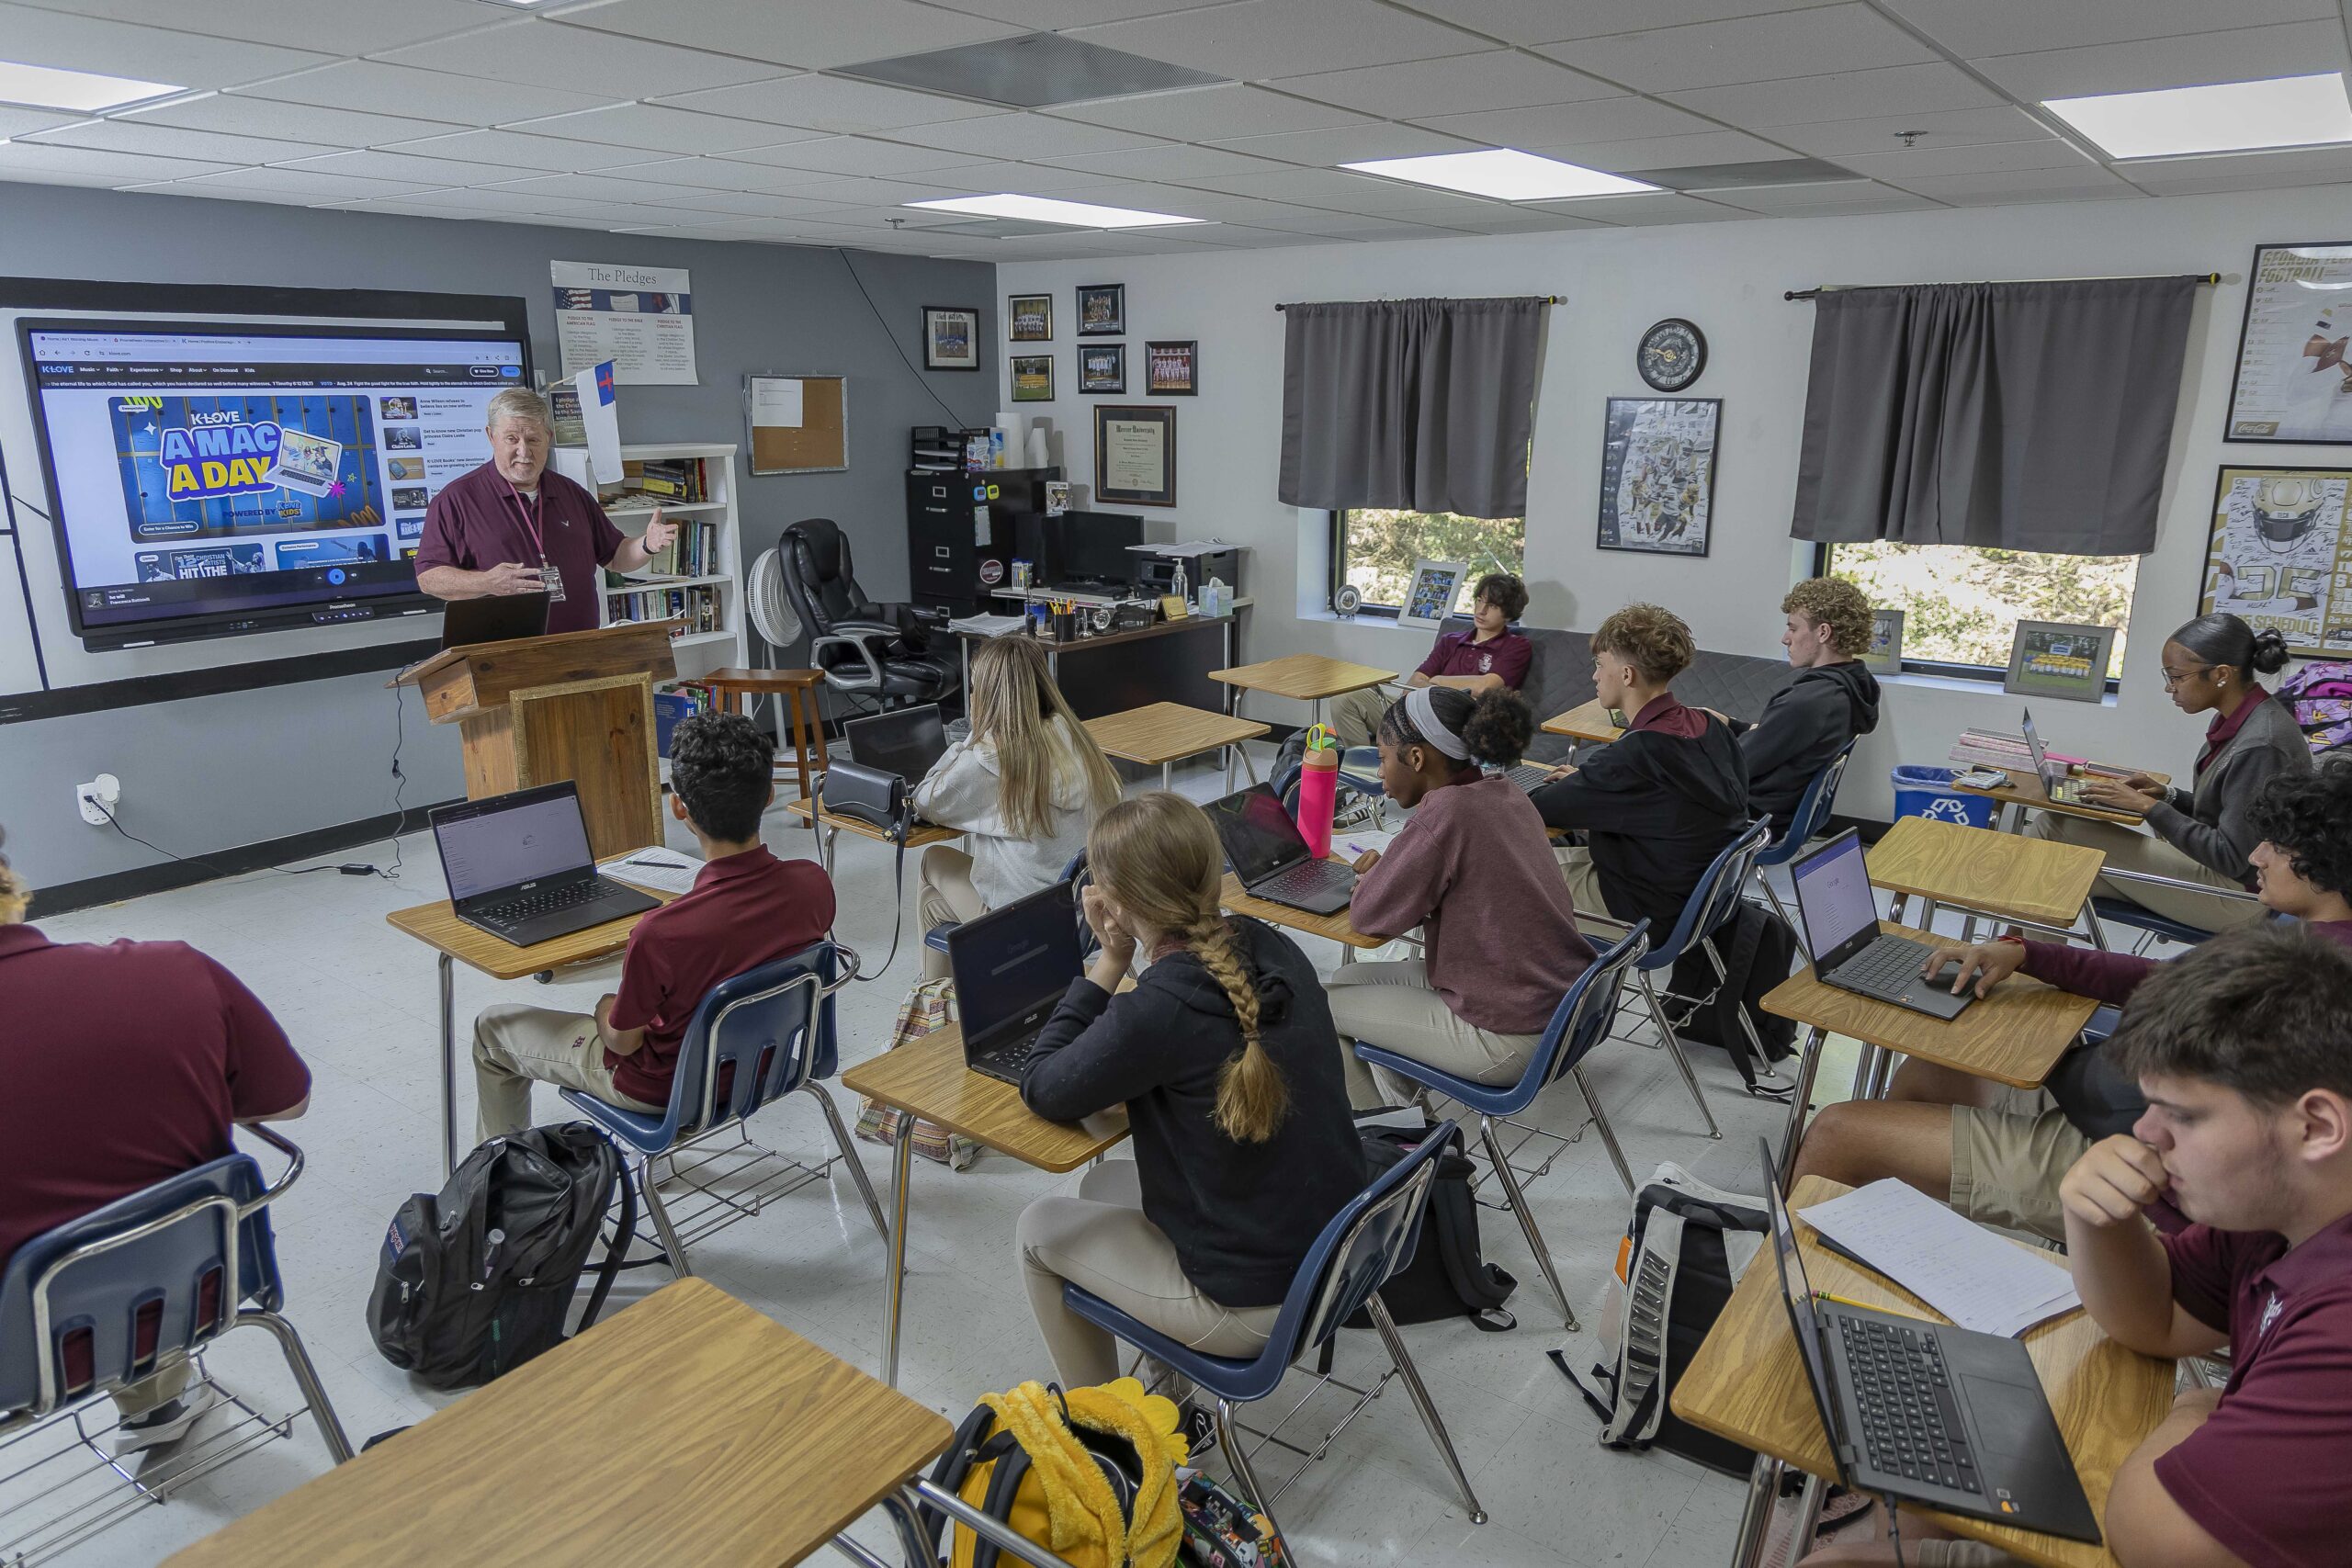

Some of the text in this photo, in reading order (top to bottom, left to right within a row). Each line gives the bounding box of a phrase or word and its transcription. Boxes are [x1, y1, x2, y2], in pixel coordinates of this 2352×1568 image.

[588, 267, 657, 286] The Pledges
[1116, 424, 1155, 434] Mercer University
[165, 425, 277, 460] A MAC
[172, 456, 272, 492] A DAY
[222, 509, 264, 517] POWERED
[279, 509, 300, 518] KIDS
[178, 557, 198, 568] 12
[179, 565, 228, 579] HIT THE
[2238, 566, 2322, 600] 25
[2253, 615, 2319, 634] SCHEDULE
[520, 882, 537, 891] ASUS
[1024, 1013, 1038, 1024] ASUS
